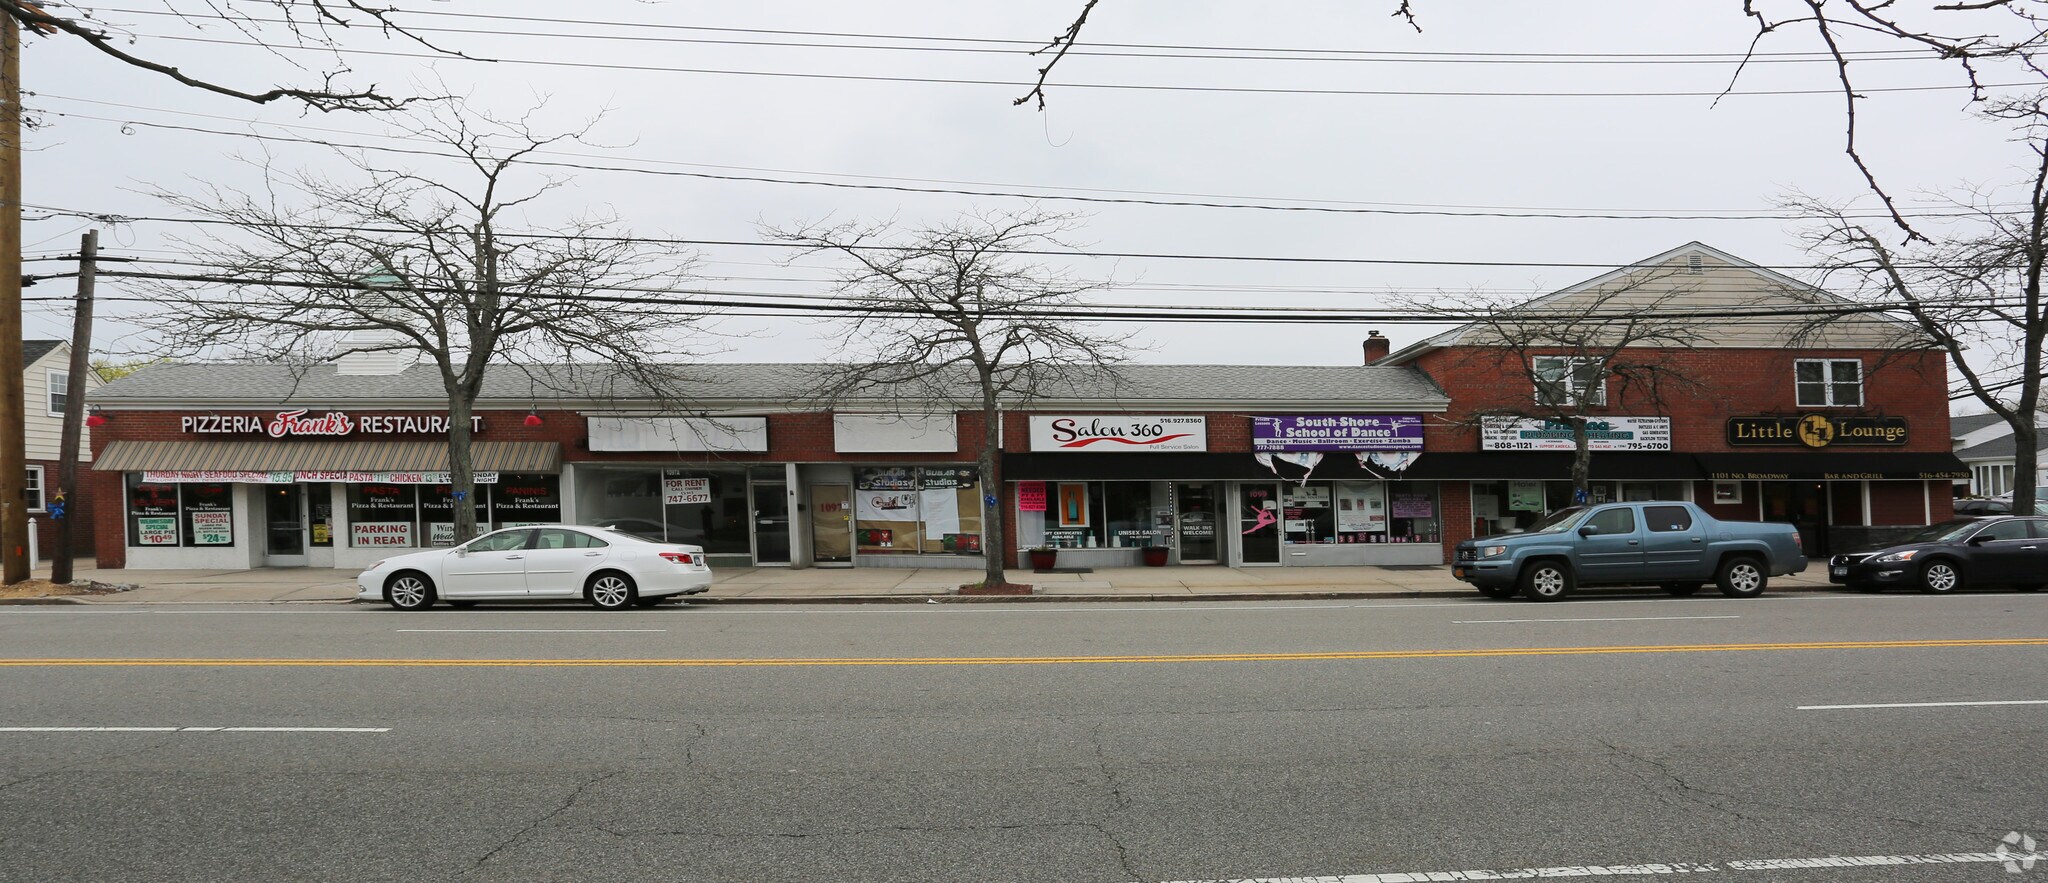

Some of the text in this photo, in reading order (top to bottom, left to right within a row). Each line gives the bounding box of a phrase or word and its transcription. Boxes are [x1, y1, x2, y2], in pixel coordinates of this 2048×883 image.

[182, 408, 482, 438] PIZZERIA Frank's RESTAURAT
[1296, 416, 1380, 426] South Shore
[1052, 418, 1163, 442] Salon 360
[1286, 427, 1391, 438] School of Dance
[1736, 422, 1792, 438] Little
[1840, 422, 1906, 441] Lounge
[295, 470, 346, 479] UNCH SPECIA
[349, 473, 373, 482] PASTA
[390, 474, 422, 482] CHICKEN
[364, 486, 400, 496] PASTA
[505, 487, 548, 496] PANINIS
[667, 494, 708, 502] 747-6677
[821, 503, 842, 512] 1097
[354, 524, 408, 534] PARKING
[203, 534, 219, 542] $24
[358, 536, 405, 544] IN REAR
